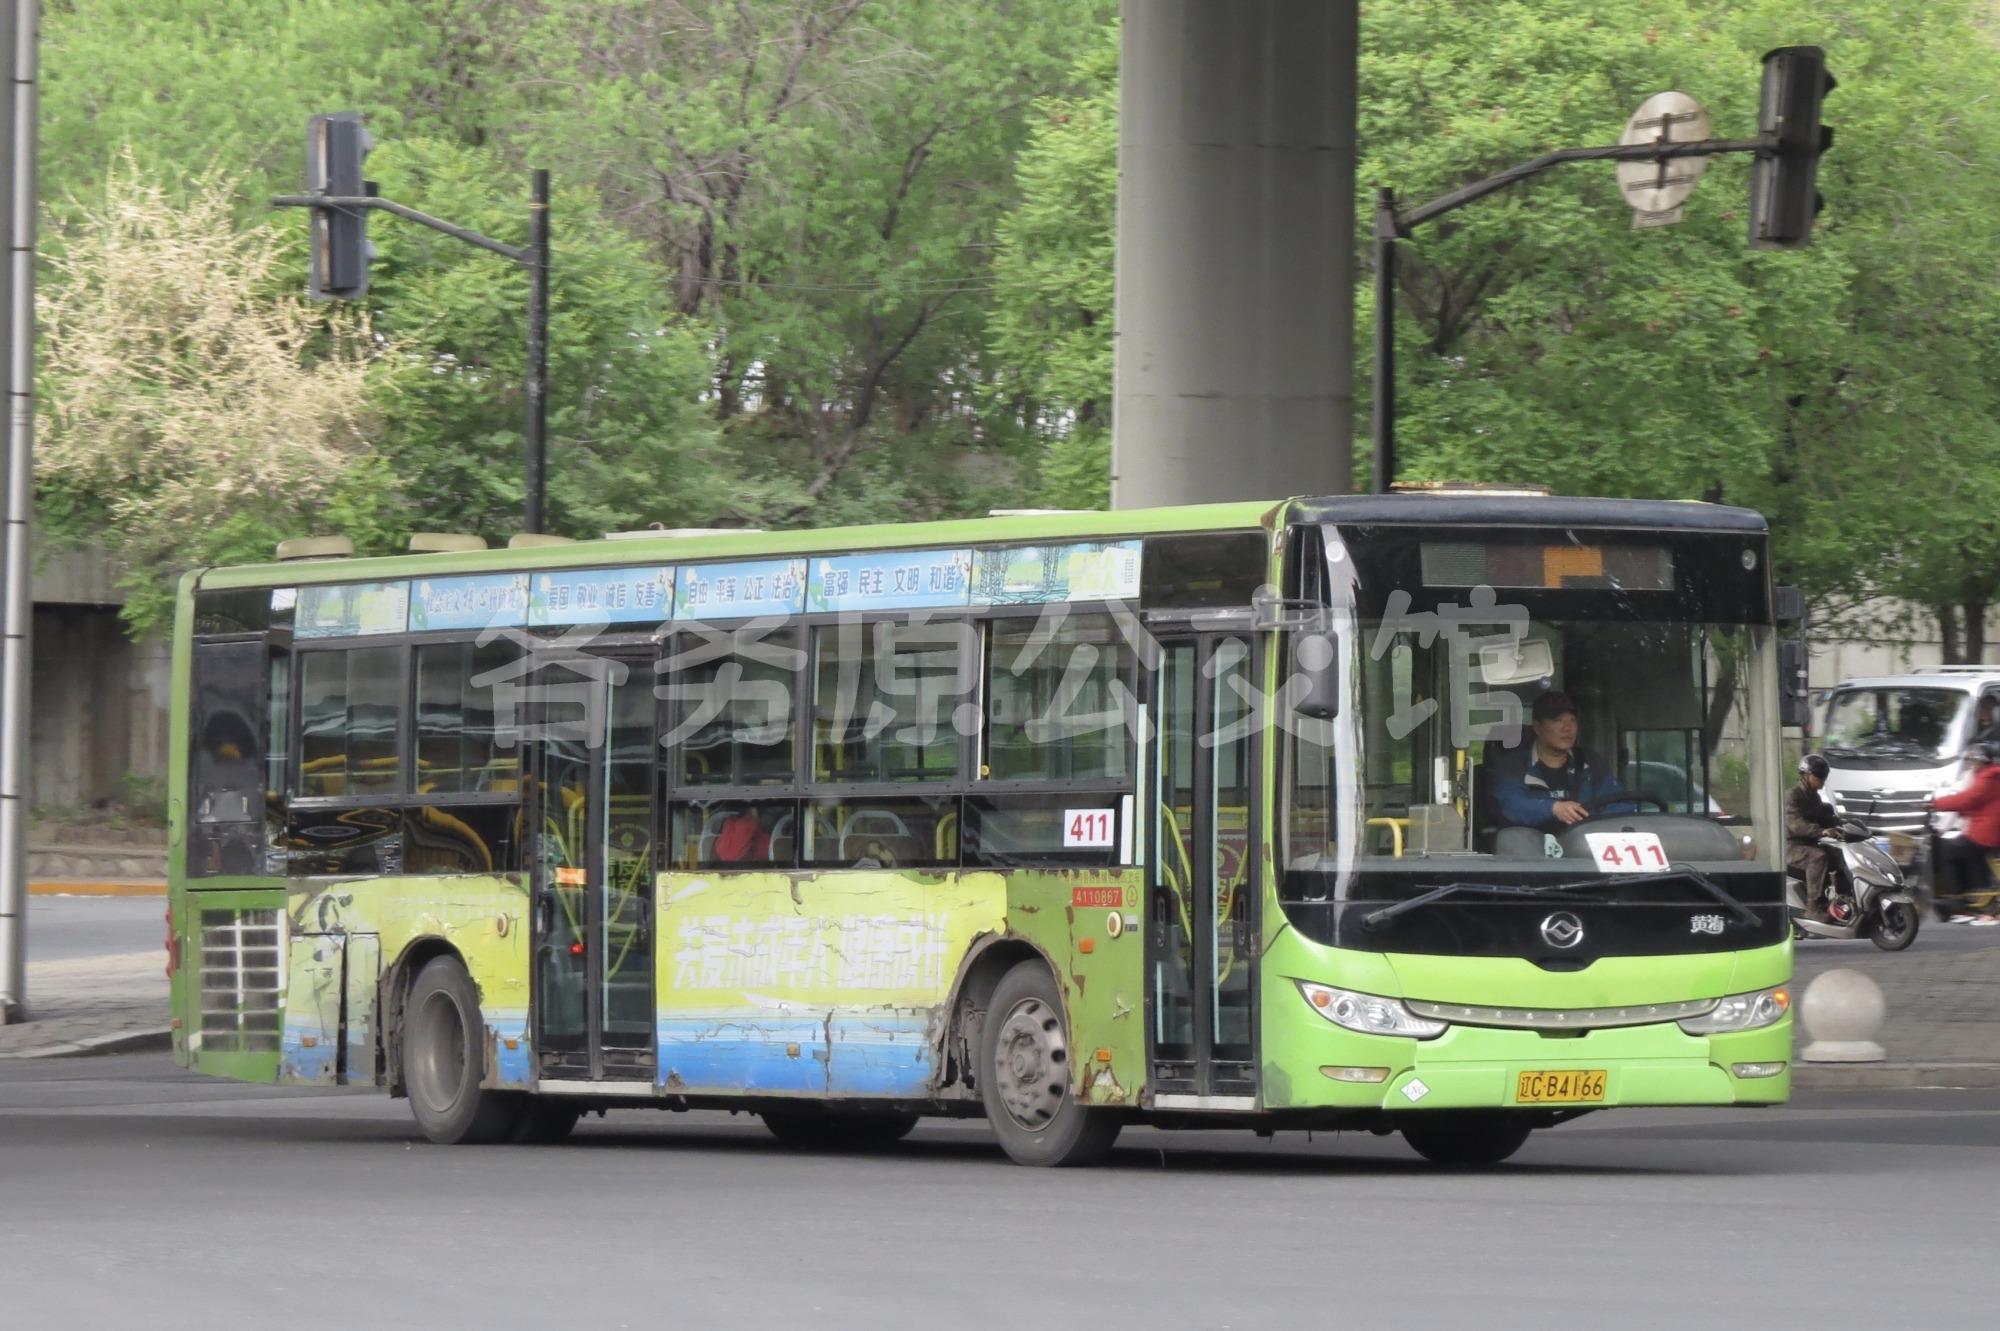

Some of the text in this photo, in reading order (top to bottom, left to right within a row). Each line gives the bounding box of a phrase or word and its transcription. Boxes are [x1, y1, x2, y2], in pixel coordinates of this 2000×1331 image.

[688, 571, 794, 605] 自由 平等 公正 法治
[822, 562, 957, 598] 富强 民主 文明 和谐
[548, 579, 658, 612] 爱国 敬业 诚信 友善
[1071, 813, 1108, 842] 411
[1601, 844, 1667, 867] 411
[1076, 890, 1119, 904] 4110867
[1690, 914, 1725, 935] 黄海
[1404, 1084, 1426, 1096] LNG
